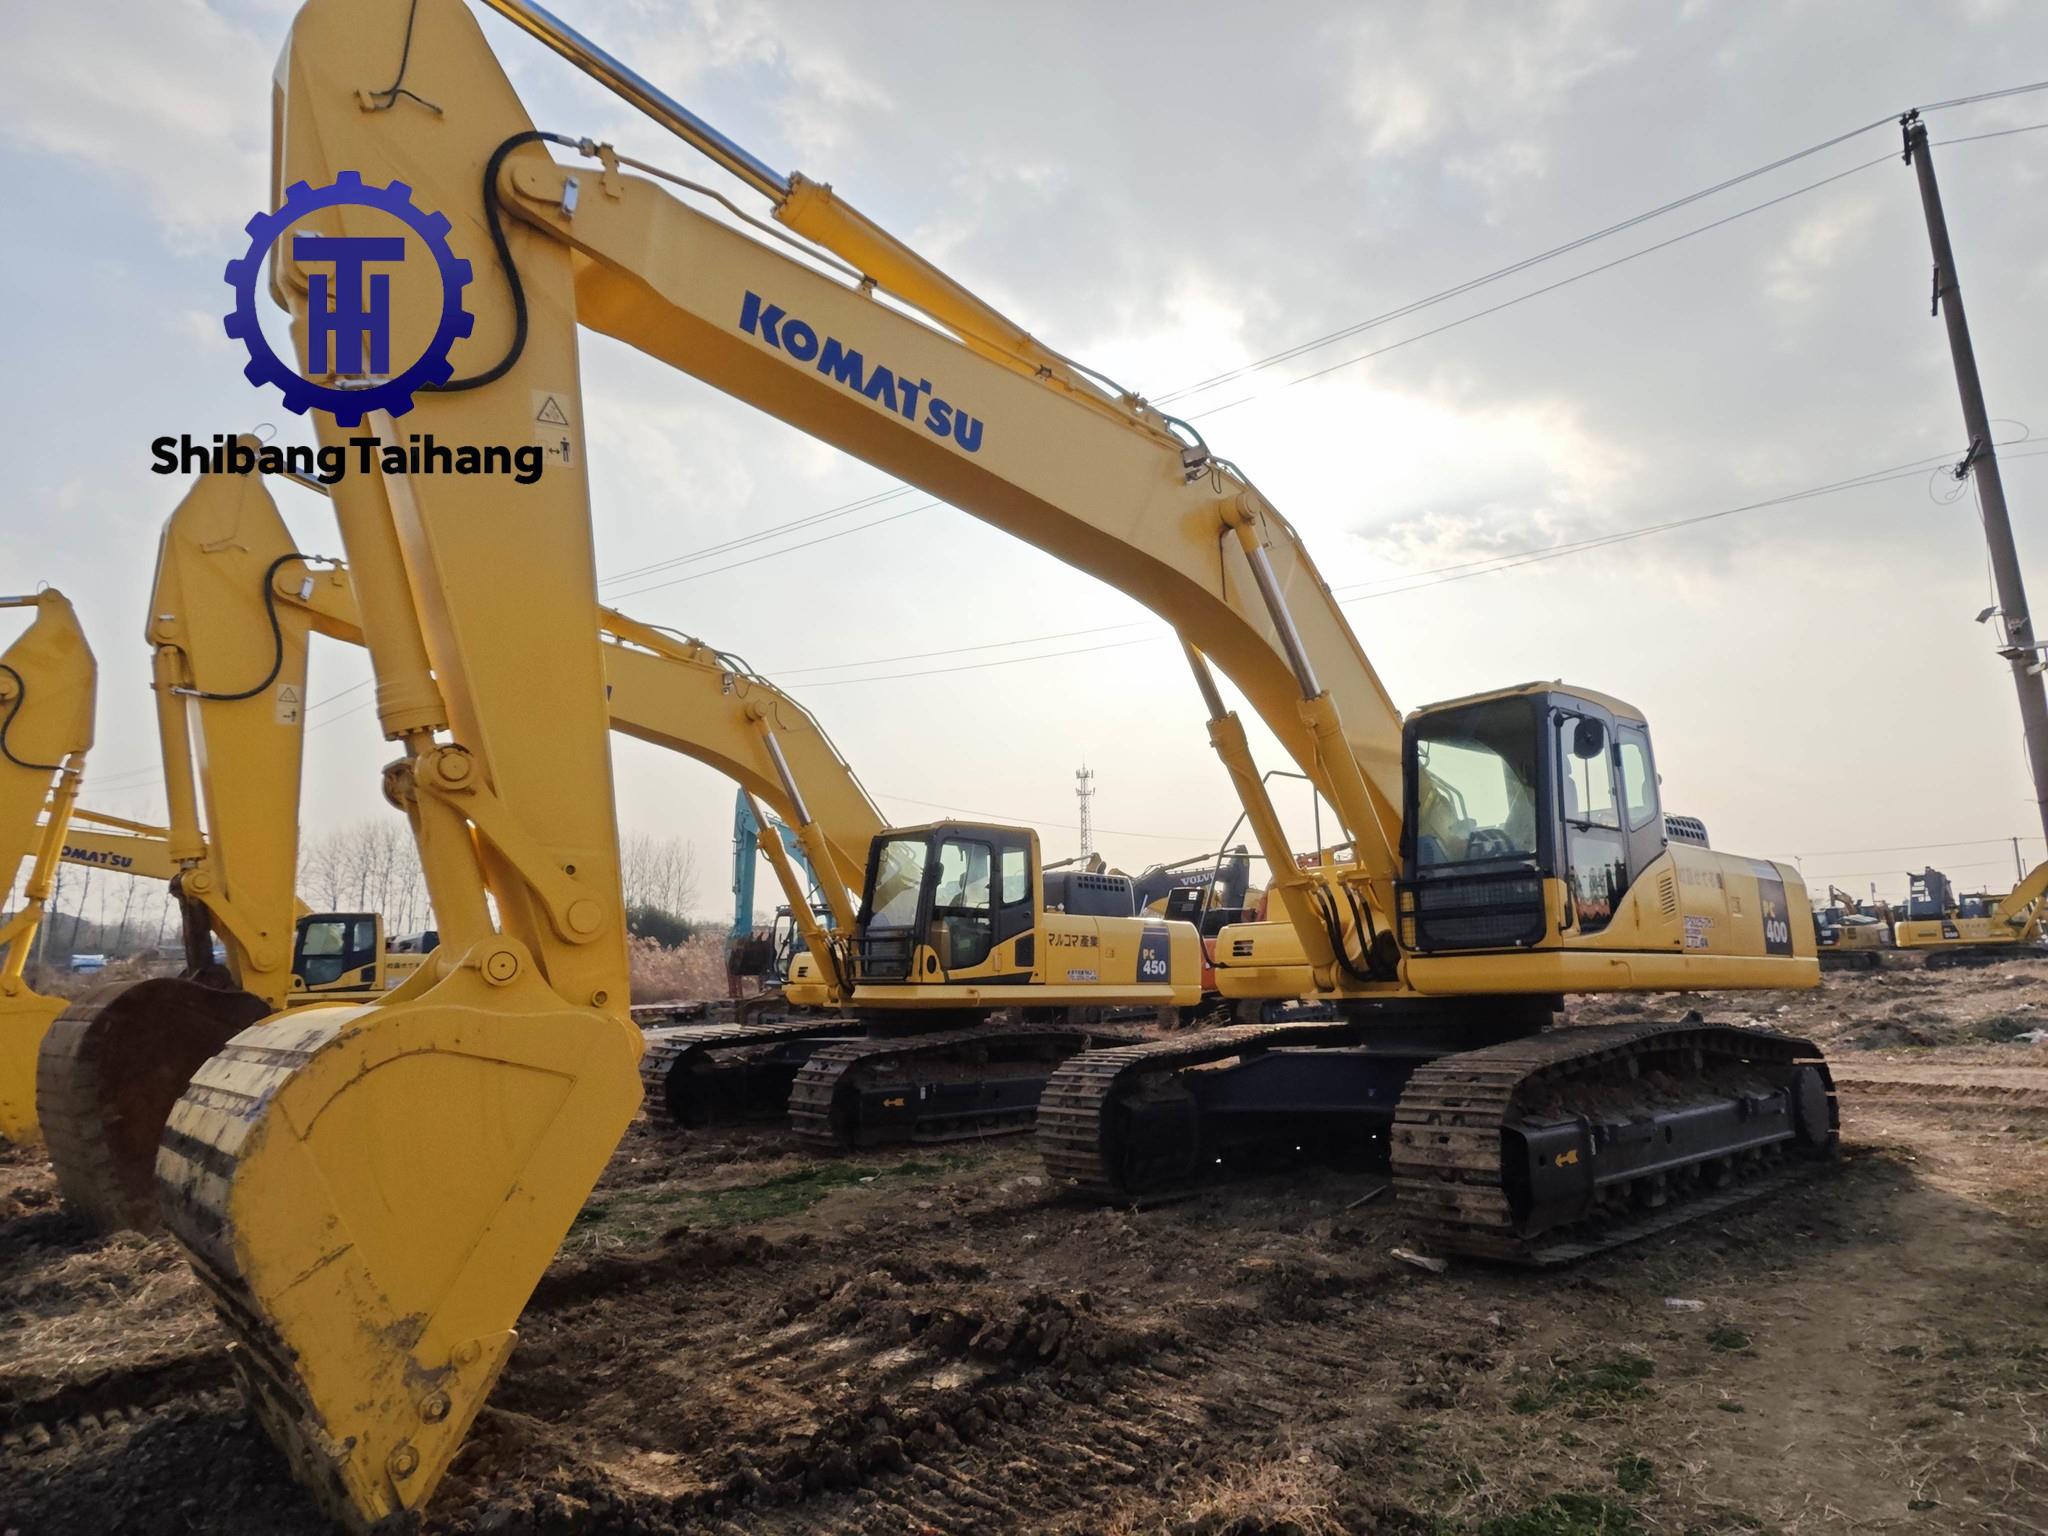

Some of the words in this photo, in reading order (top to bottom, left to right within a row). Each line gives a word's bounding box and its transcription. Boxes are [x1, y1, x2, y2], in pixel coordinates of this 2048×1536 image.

[739, 289, 984, 453] KOMATSU
[61, 845, 133, 868] OMATSU
[1766, 919, 1788, 944] 400
[1142, 949, 1155, 960] PC
[1142, 960, 1166, 975] 450
